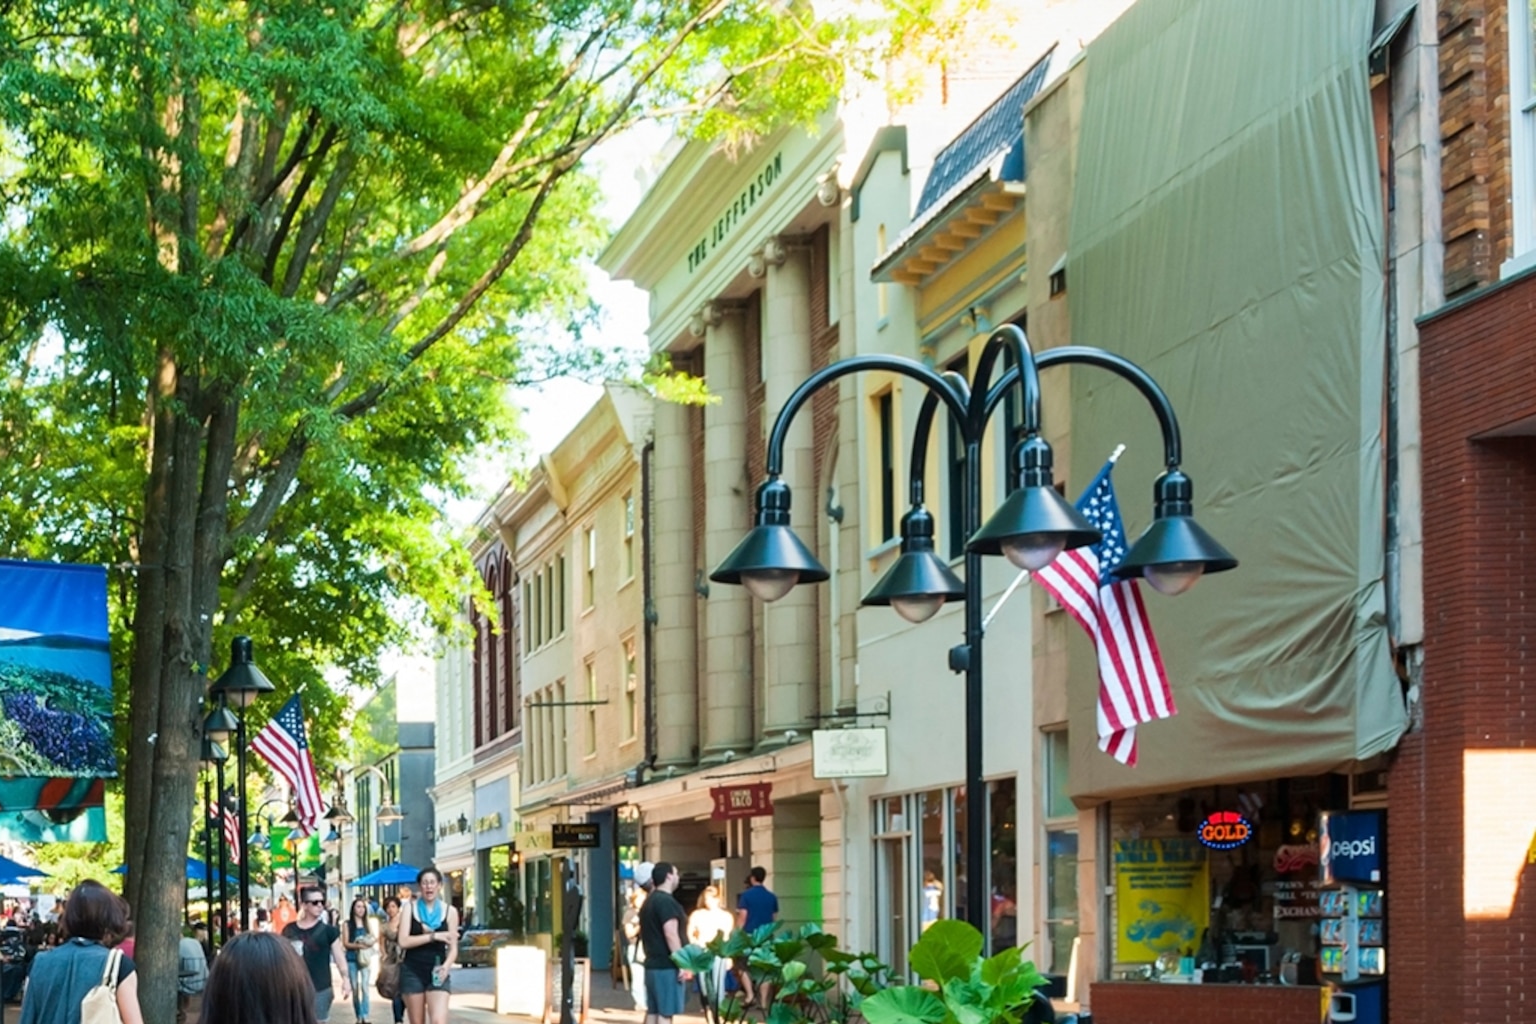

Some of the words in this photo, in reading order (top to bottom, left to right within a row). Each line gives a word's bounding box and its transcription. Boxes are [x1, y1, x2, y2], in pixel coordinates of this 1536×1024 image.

[687, 237, 707, 274] THE
[711, 151, 783, 249] JEFFERSON
[731, 795, 753, 808] TACO
[1202, 823, 1249, 841] GOLD
[1331, 835, 1375, 860] pepsi
